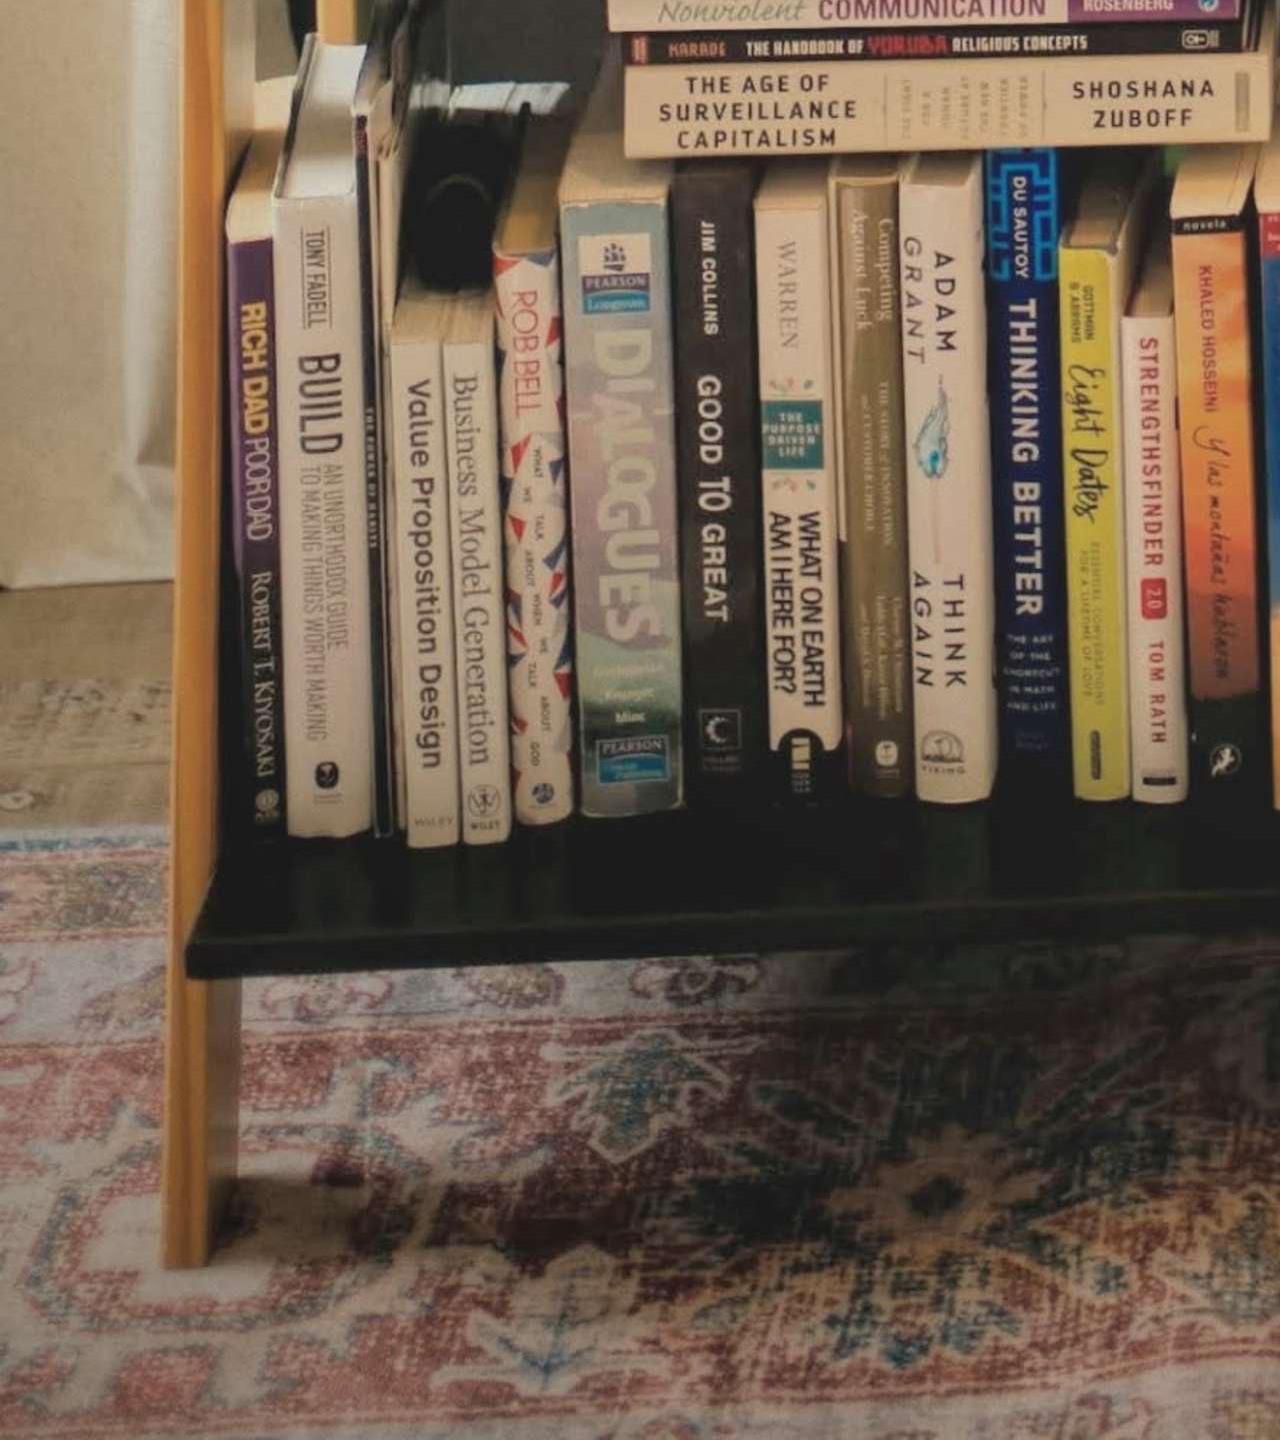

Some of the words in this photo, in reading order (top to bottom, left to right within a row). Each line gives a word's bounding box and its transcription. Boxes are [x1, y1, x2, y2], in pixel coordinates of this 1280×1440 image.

[659, 100, 857, 122] SURVEILLANCE
[686, 76, 731, 94] THE
[742, 75, 789, 92] AGE
[800, 74, 830, 91] OF
[1072, 78, 1214, 99] SHOSHANA
[678, 129, 836, 148] CAPITALISM
[1092, 108, 1192, 128] ZUBOFF
[1013, 177, 1027, 201] DU
[305, 231, 324, 268] TONY
[701, 221, 715, 251] JIM
[1013, 208, 1029, 279] SAUTOY
[307, 272, 327, 329] FADELL
[584, 276, 647, 290] PEARSON
[702, 257, 719, 335] COLLINS
[904, 237, 925, 364] GRANT
[934, 251, 957, 351] ADAM
[241, 301, 267, 370] RICH
[511, 291, 539, 351] ROB
[244, 376, 269, 434] DAD
[298, 354, 342, 455] BUILD
[513, 359, 541, 417] BELL
[1009, 299, 1040, 463] THINKING
[407, 380, 435, 467] Value
[452, 376, 480, 496] Business
[697, 376, 722, 464] GOOD
[763, 424, 820, 434] PURPOSE
[769, 435, 815, 445] DRIVEN
[779, 412, 803, 423] THE
[245, 437, 270, 496] POOR
[778, 446, 805, 457] LIFE
[1140, 338, 1164, 565] STRENGTHSFINDER
[246, 496, 272, 540] DAD
[698, 476, 732, 512] TO
[408, 478, 442, 654] Proposition
[459, 507, 491, 597] Model
[701, 524, 727, 622] GREAT
[1013, 482, 1043, 616] BETTER
[913, 572, 934, 687] AGAIN
[942, 573, 966, 687] THINK
[462, 607, 495, 765] Generation
[415, 665, 446, 768] Design
